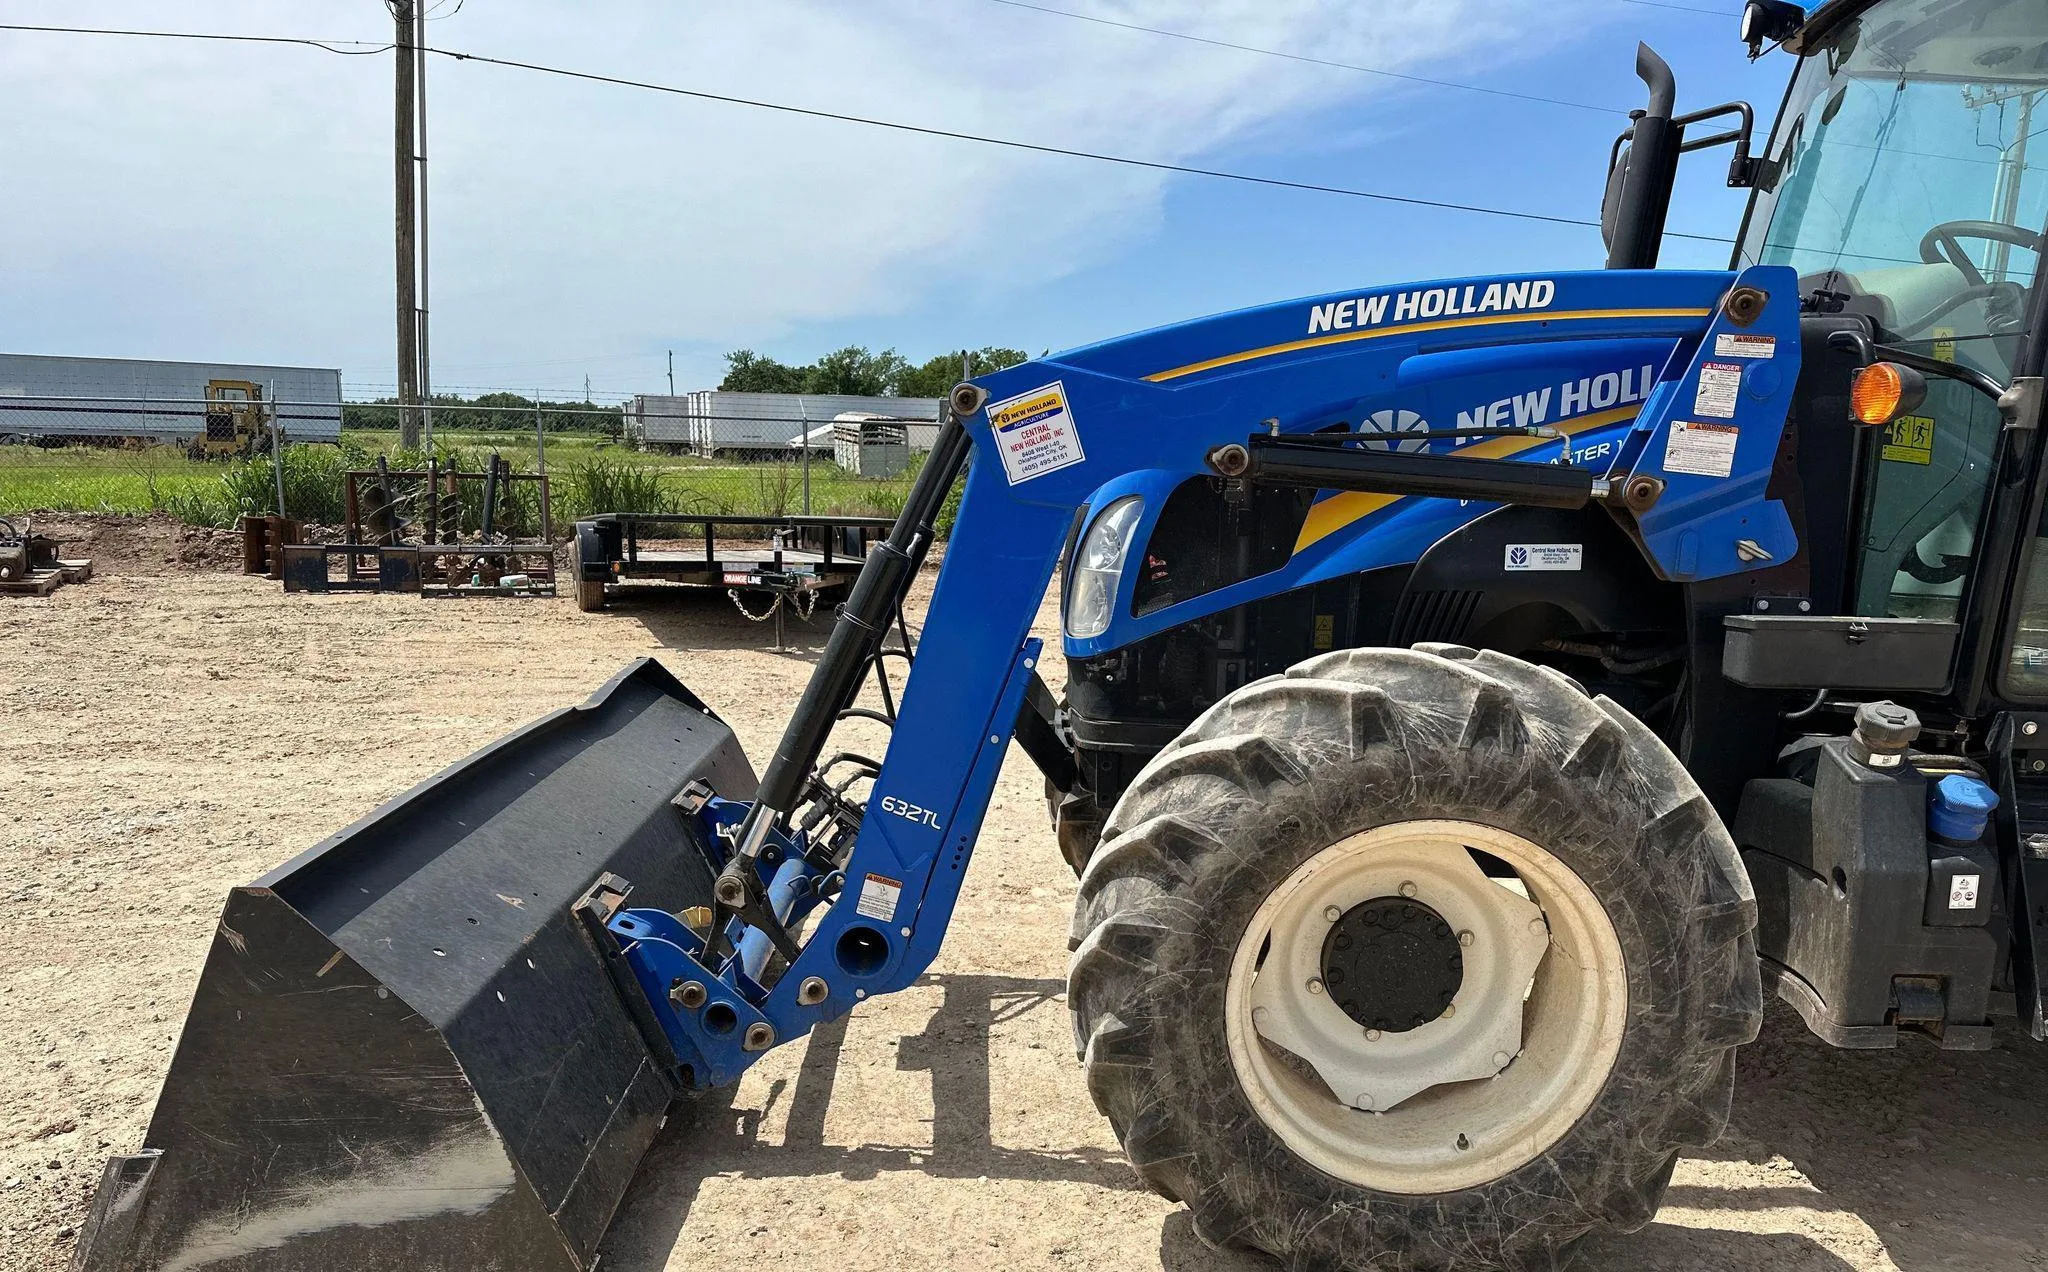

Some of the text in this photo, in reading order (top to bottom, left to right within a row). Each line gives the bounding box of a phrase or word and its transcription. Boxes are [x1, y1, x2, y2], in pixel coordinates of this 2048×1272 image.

[1308, 280, 1556, 334] NEW HOLLAND
[1742, 335, 1774, 343] WARNING
[1712, 362, 1740, 371] DANGER
[1011, 399, 1057, 419] NEW HOLLAND
[1455, 386, 1552, 446] NEW
[1013, 412, 1049, 428] AGRICULTURE
[1021, 423, 1051, 440] CENTRAL
[1700, 423, 1732, 432] WARNING
[1010, 443, 1024, 453] NEW
[1017, 451, 1045, 465] Oklahoma
[1059, 444, 1068, 452] OK
[1035, 443, 1049, 453] West
[1022, 462, 1039, 473] (405)
[723, 575, 761, 584] ORANGE LINE
[881, 795, 941, 830] 632TL
[872, 875, 902, 889] WARNING
